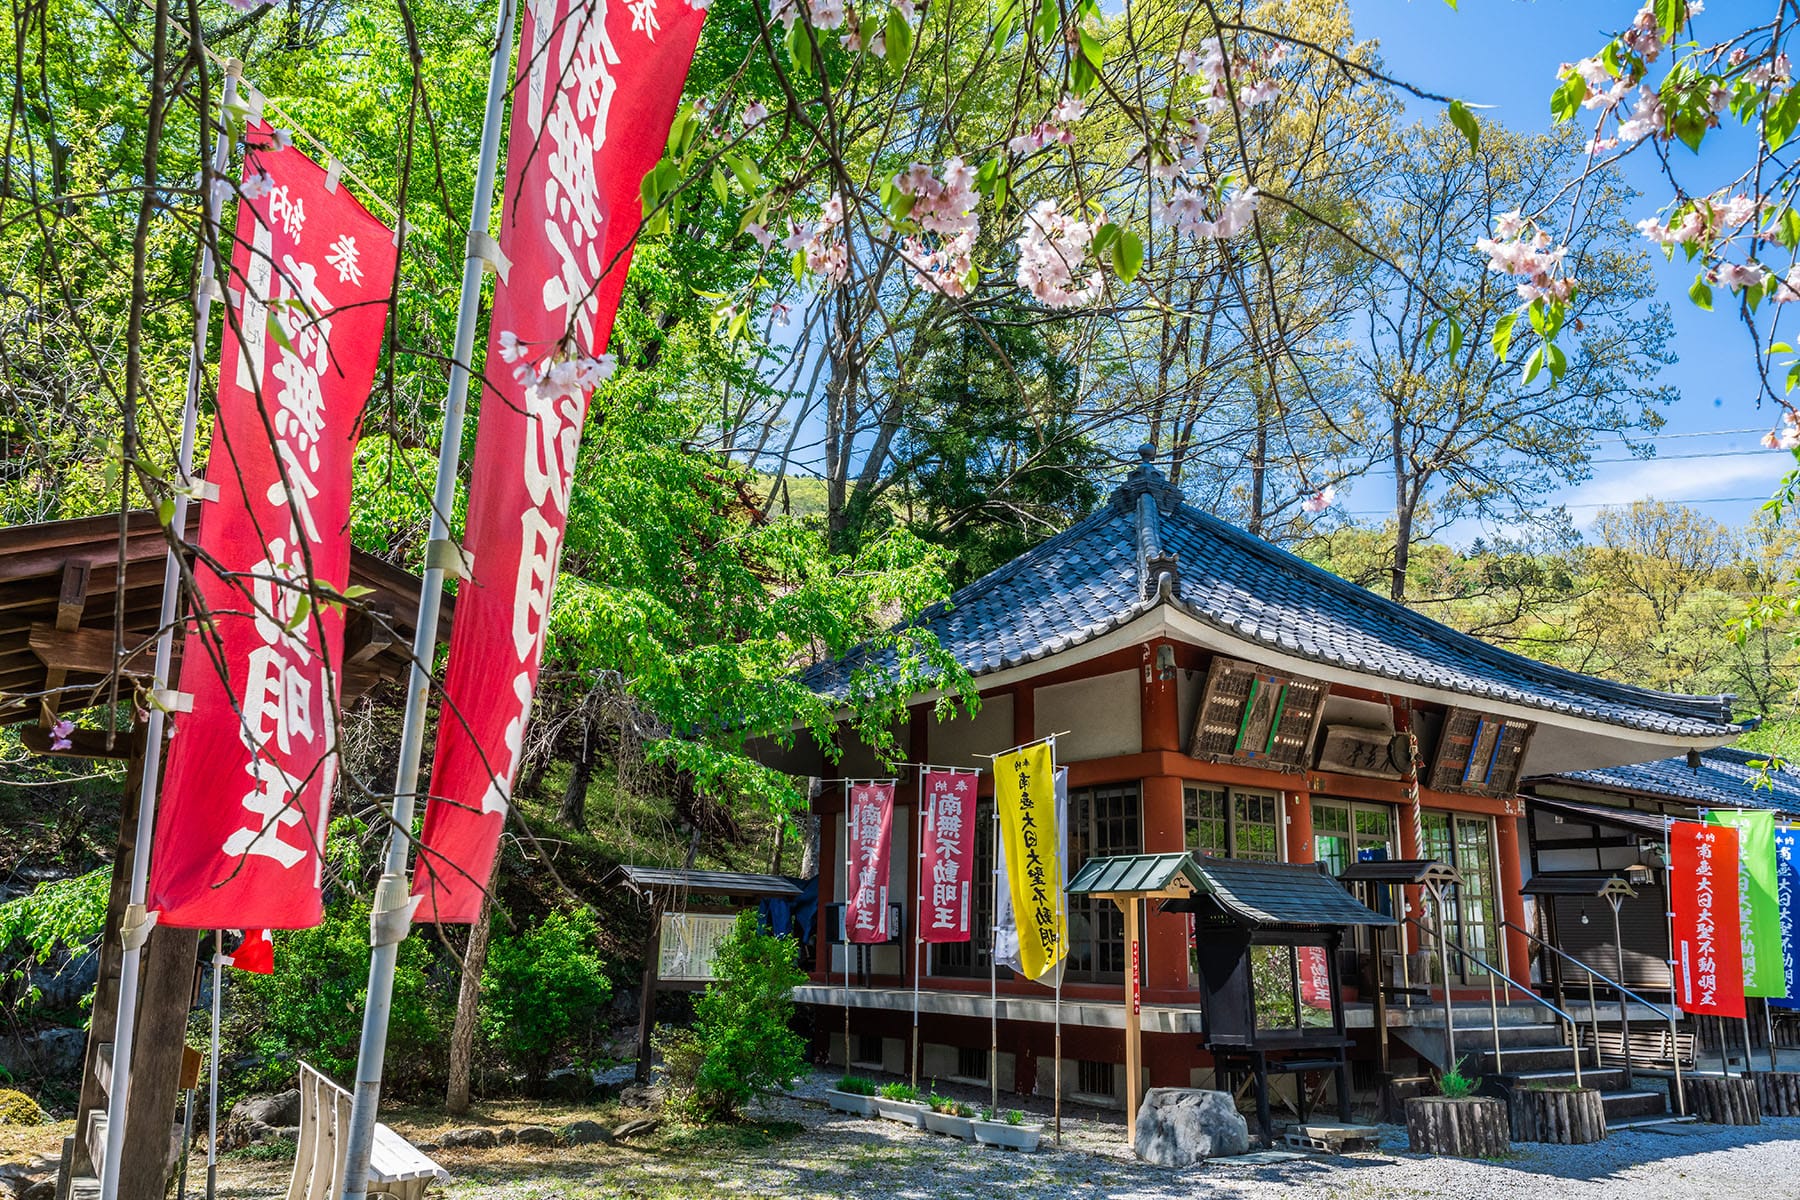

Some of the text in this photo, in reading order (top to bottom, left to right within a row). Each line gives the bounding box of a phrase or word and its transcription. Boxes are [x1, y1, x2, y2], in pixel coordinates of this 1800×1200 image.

[1696, 843, 1717, 1006] 南無大日大聖不動明王
